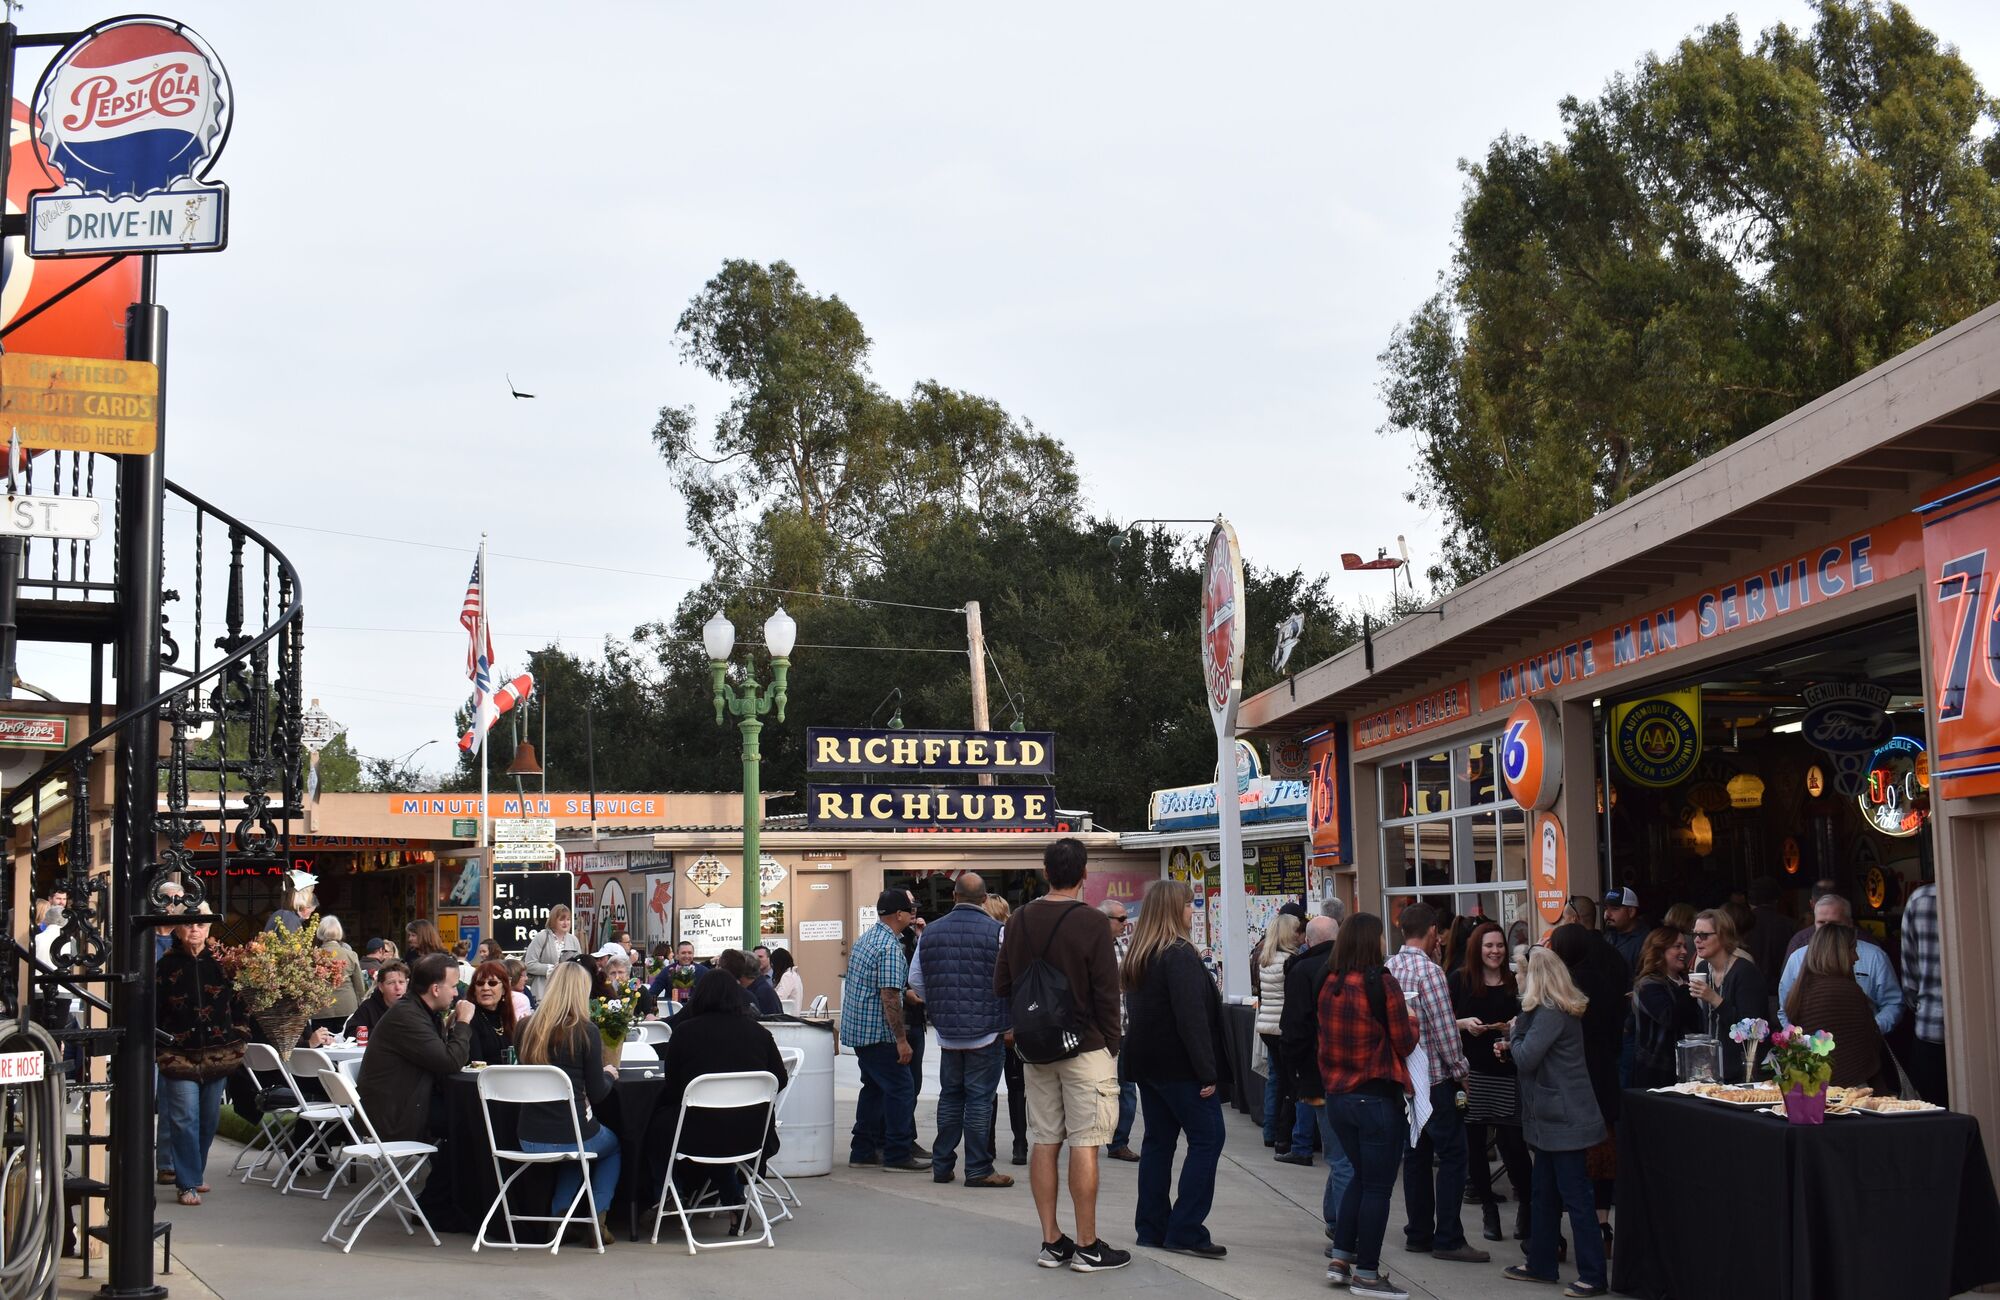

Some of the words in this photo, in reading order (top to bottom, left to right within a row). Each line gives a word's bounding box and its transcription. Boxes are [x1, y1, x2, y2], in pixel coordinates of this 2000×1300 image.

[66, 209, 173, 241] DRIVE-IN
[83, 394, 151, 417] CARDS
[95, 427, 136, 447] HERE
[1499, 638, 1596, 703] MINUTE
[1613, 606, 1678, 667] MAN
[1698, 533, 1875, 638] SERVICE
[1806, 682, 1850, 704] GENUINE
[1855, 682, 1888, 704] PARTS
[1359, 711, 1391, 745] UNION
[1394, 705, 1413, 735] OIL
[1415, 688, 1460, 728] DEALER
[1625, 704, 1671, 732] AUTOMOBILE
[1672, 711, 1690, 731] CLUB
[1813, 709, 1881, 741] Ford
[1641, 728, 1675, 749] AAA
[816, 736, 1045, 766] RICHFIELD
[1624, 739, 1655, 777] SOUTHERN
[1660, 739, 1694, 777] CALIFORNIA
[402, 798, 484, 814] MINUTE
[503, 799, 551, 814] MAN
[566, 799, 656, 814] SERVICE
[817, 792, 1047, 820] RICHLUBE
[495, 883, 514, 899] El
[1106, 880, 1134, 898] ALL
[492, 904, 551, 920] Camin
[693, 918, 732, 928] PENALTY
[760, 940, 778, 948] ARKING
[17, 1056, 41, 1077] HOSE
